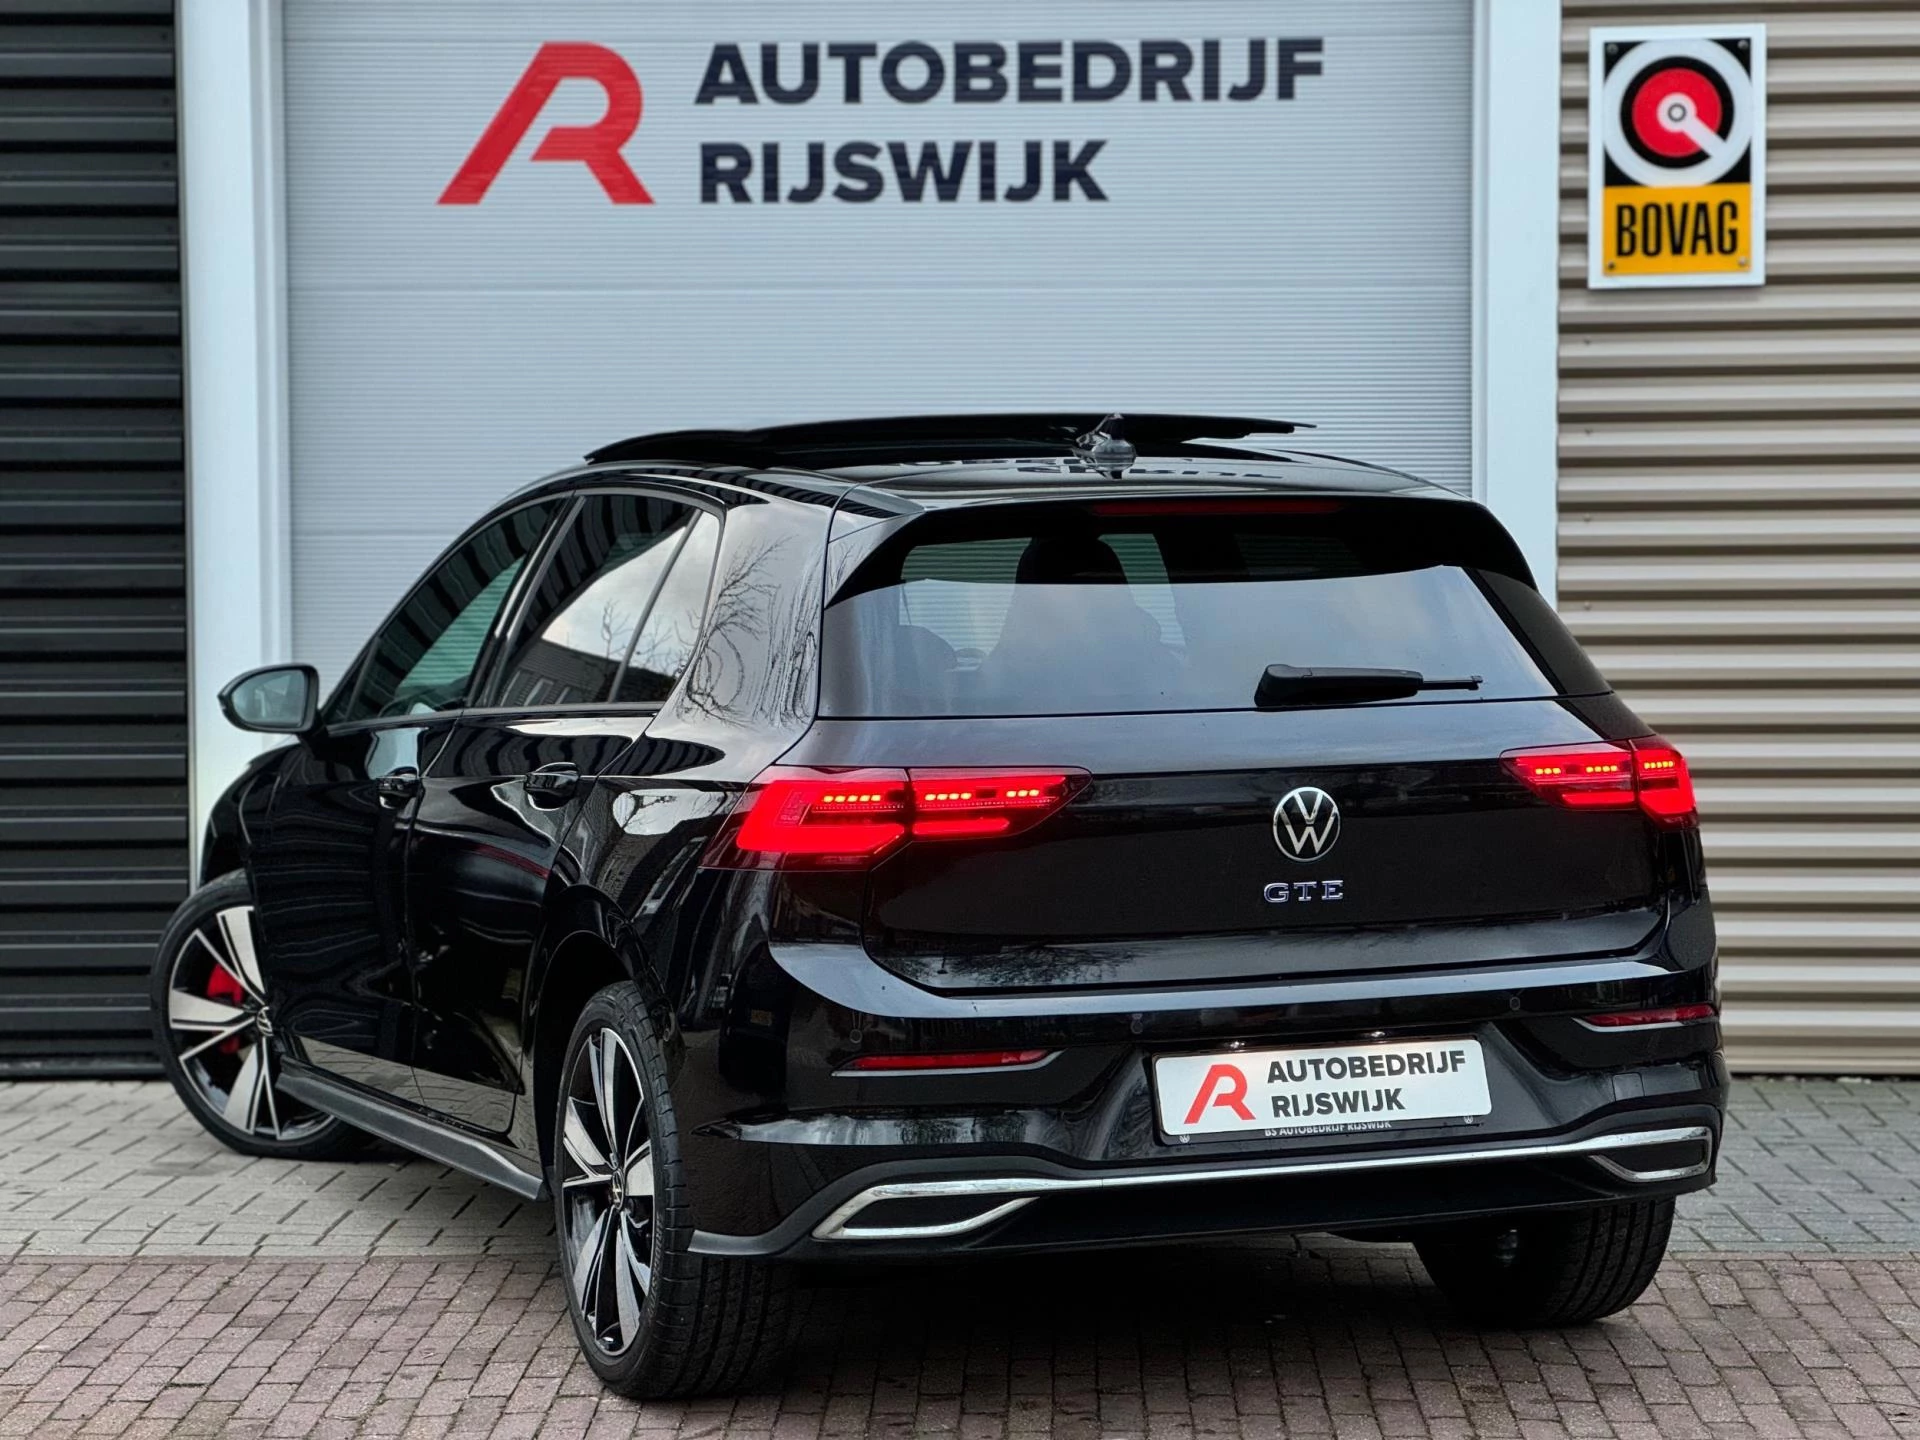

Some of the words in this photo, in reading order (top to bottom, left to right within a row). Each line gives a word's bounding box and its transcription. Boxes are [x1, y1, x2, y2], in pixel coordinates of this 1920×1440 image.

[695, 38, 1323, 104] AUTOBEDRIJF
[700, 140, 1108, 203] RIJSWIJK
[1617, 200, 1738, 256] BOVAG
[1263, 879, 1344, 903] GTE
[1267, 1050, 1466, 1084] AUTOBEDRIJF
[1272, 1088, 1406, 1118] RIJSWIJK
[1279, 1123, 1345, 1136] AUTOBEDRIJF
[1347, 1120, 1392, 1131] RIJSWIJK
